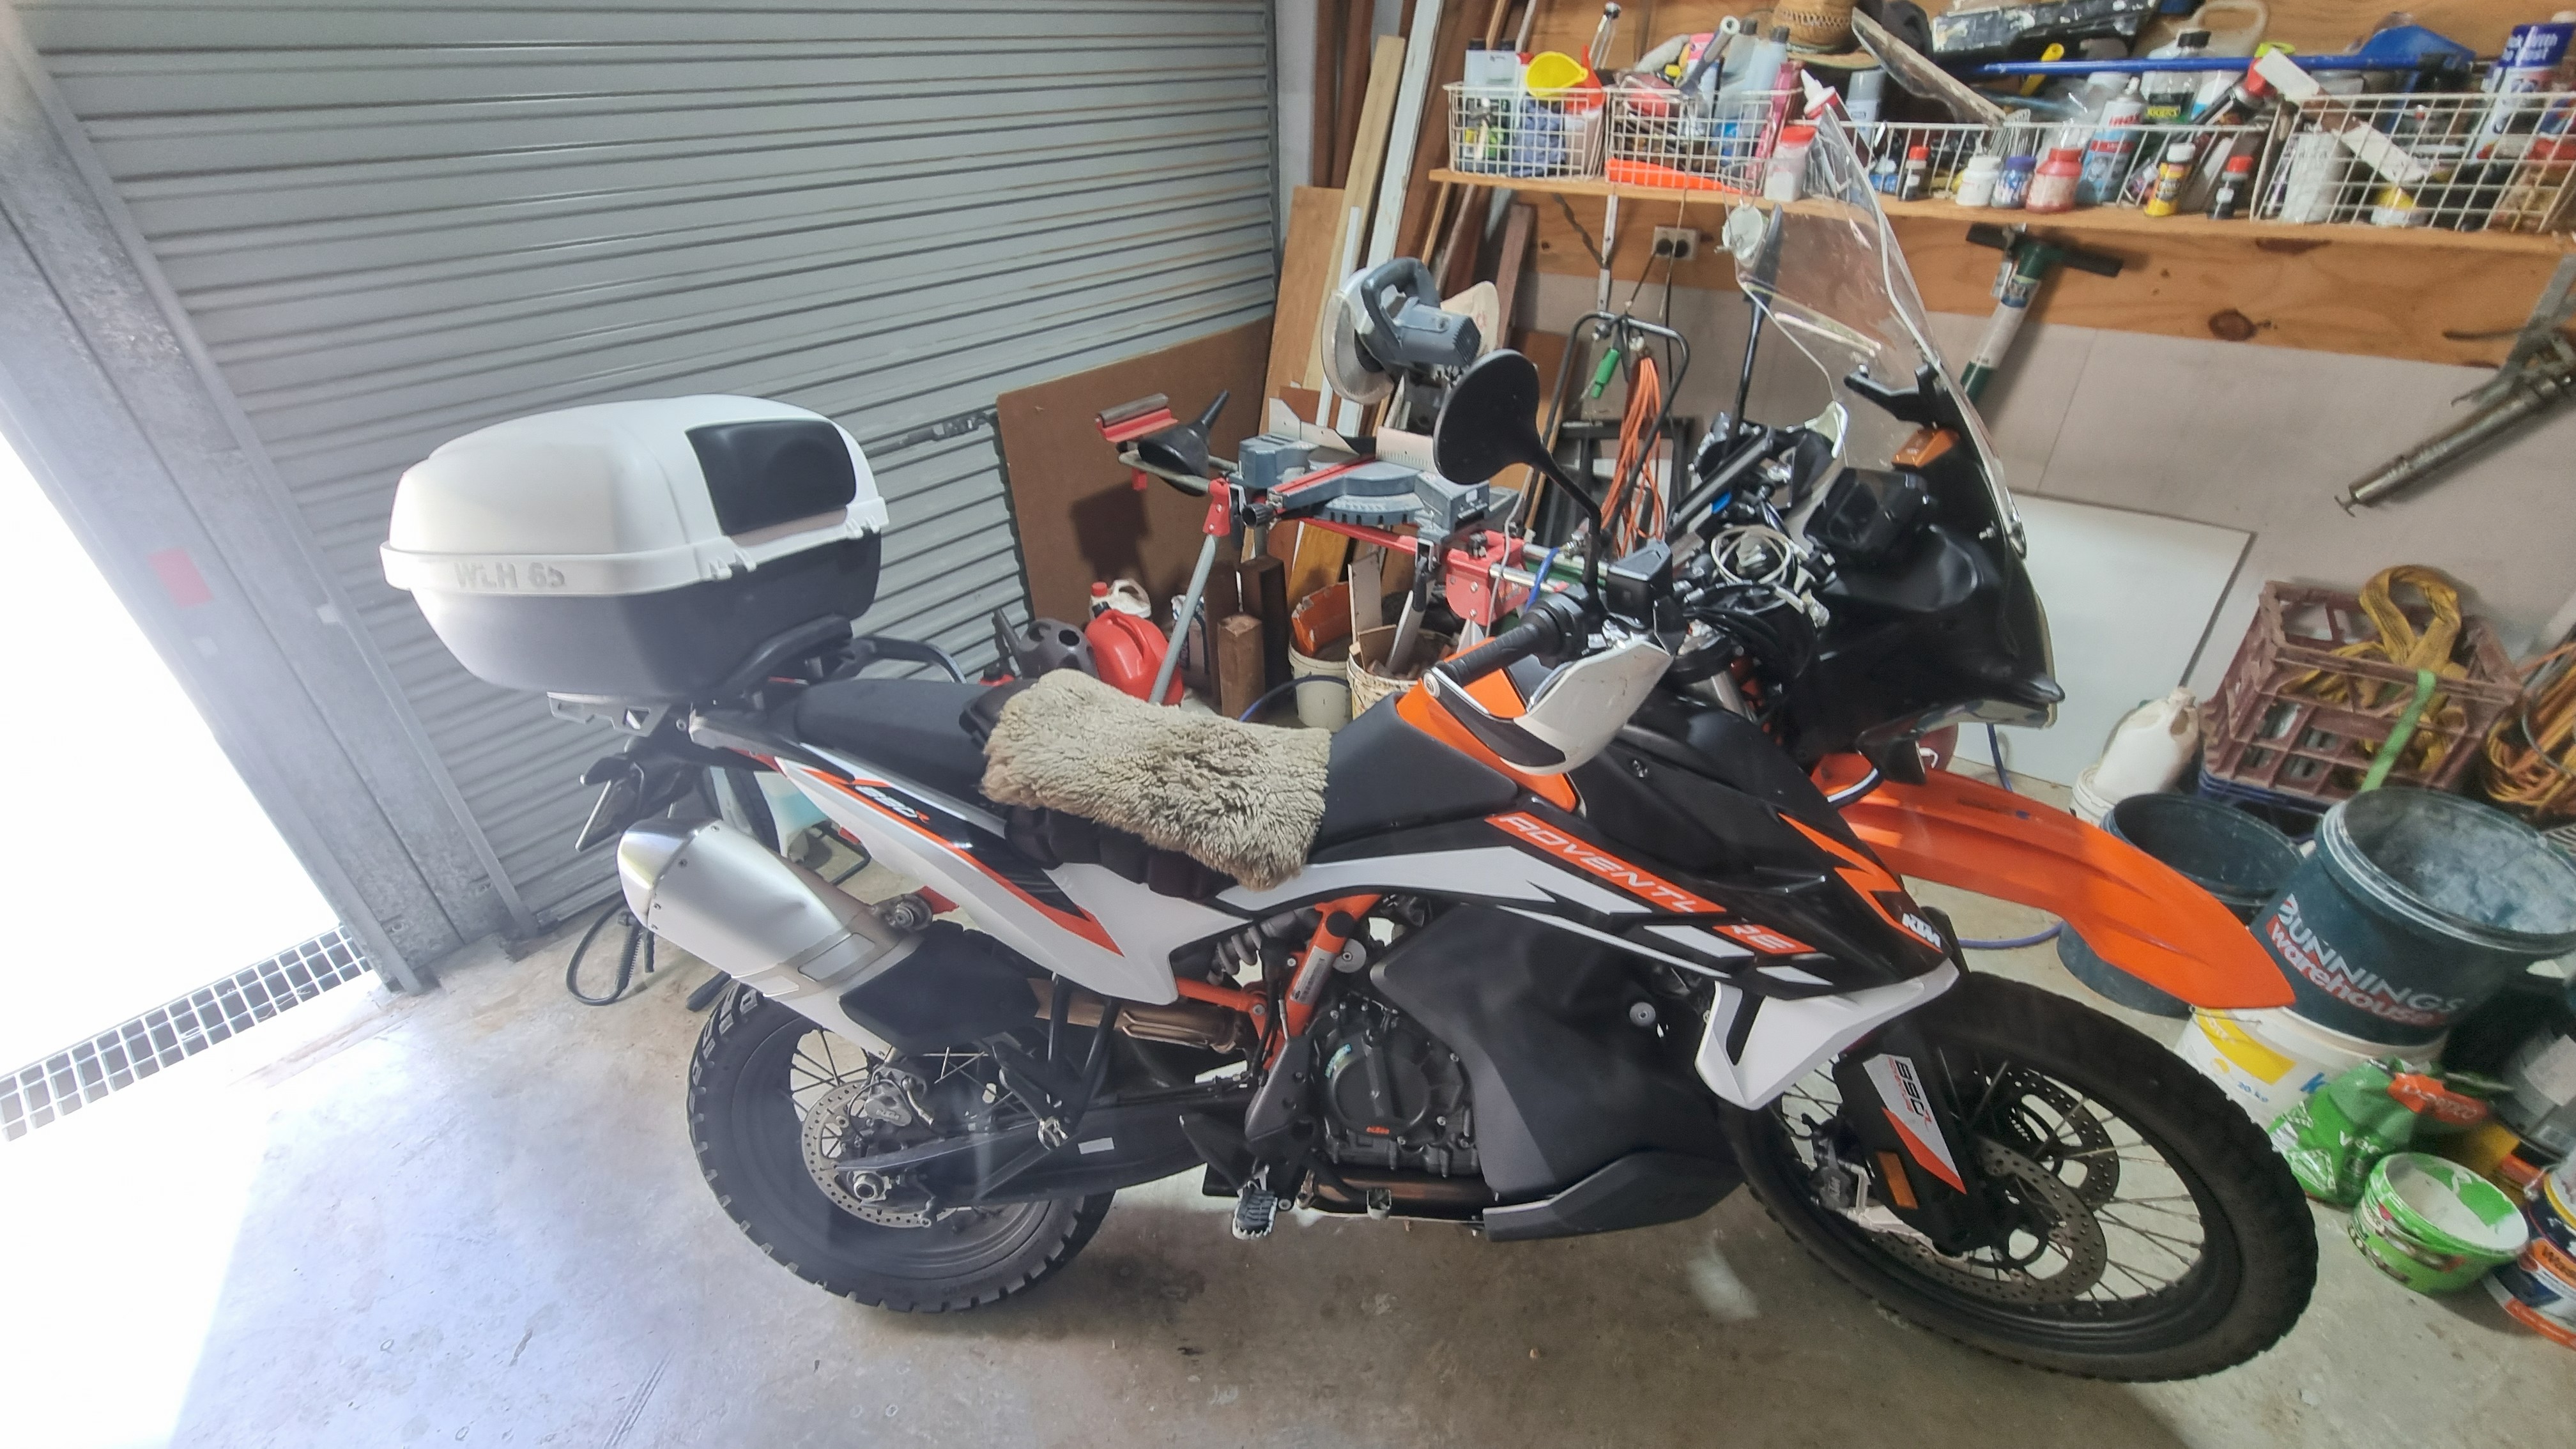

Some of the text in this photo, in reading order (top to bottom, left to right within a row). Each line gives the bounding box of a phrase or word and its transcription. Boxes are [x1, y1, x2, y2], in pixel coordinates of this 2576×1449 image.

[528, 562, 567, 588] 65
[1902, 912, 1941, 948] KTM
[2277, 893, 2466, 1013] BUNNINGS
